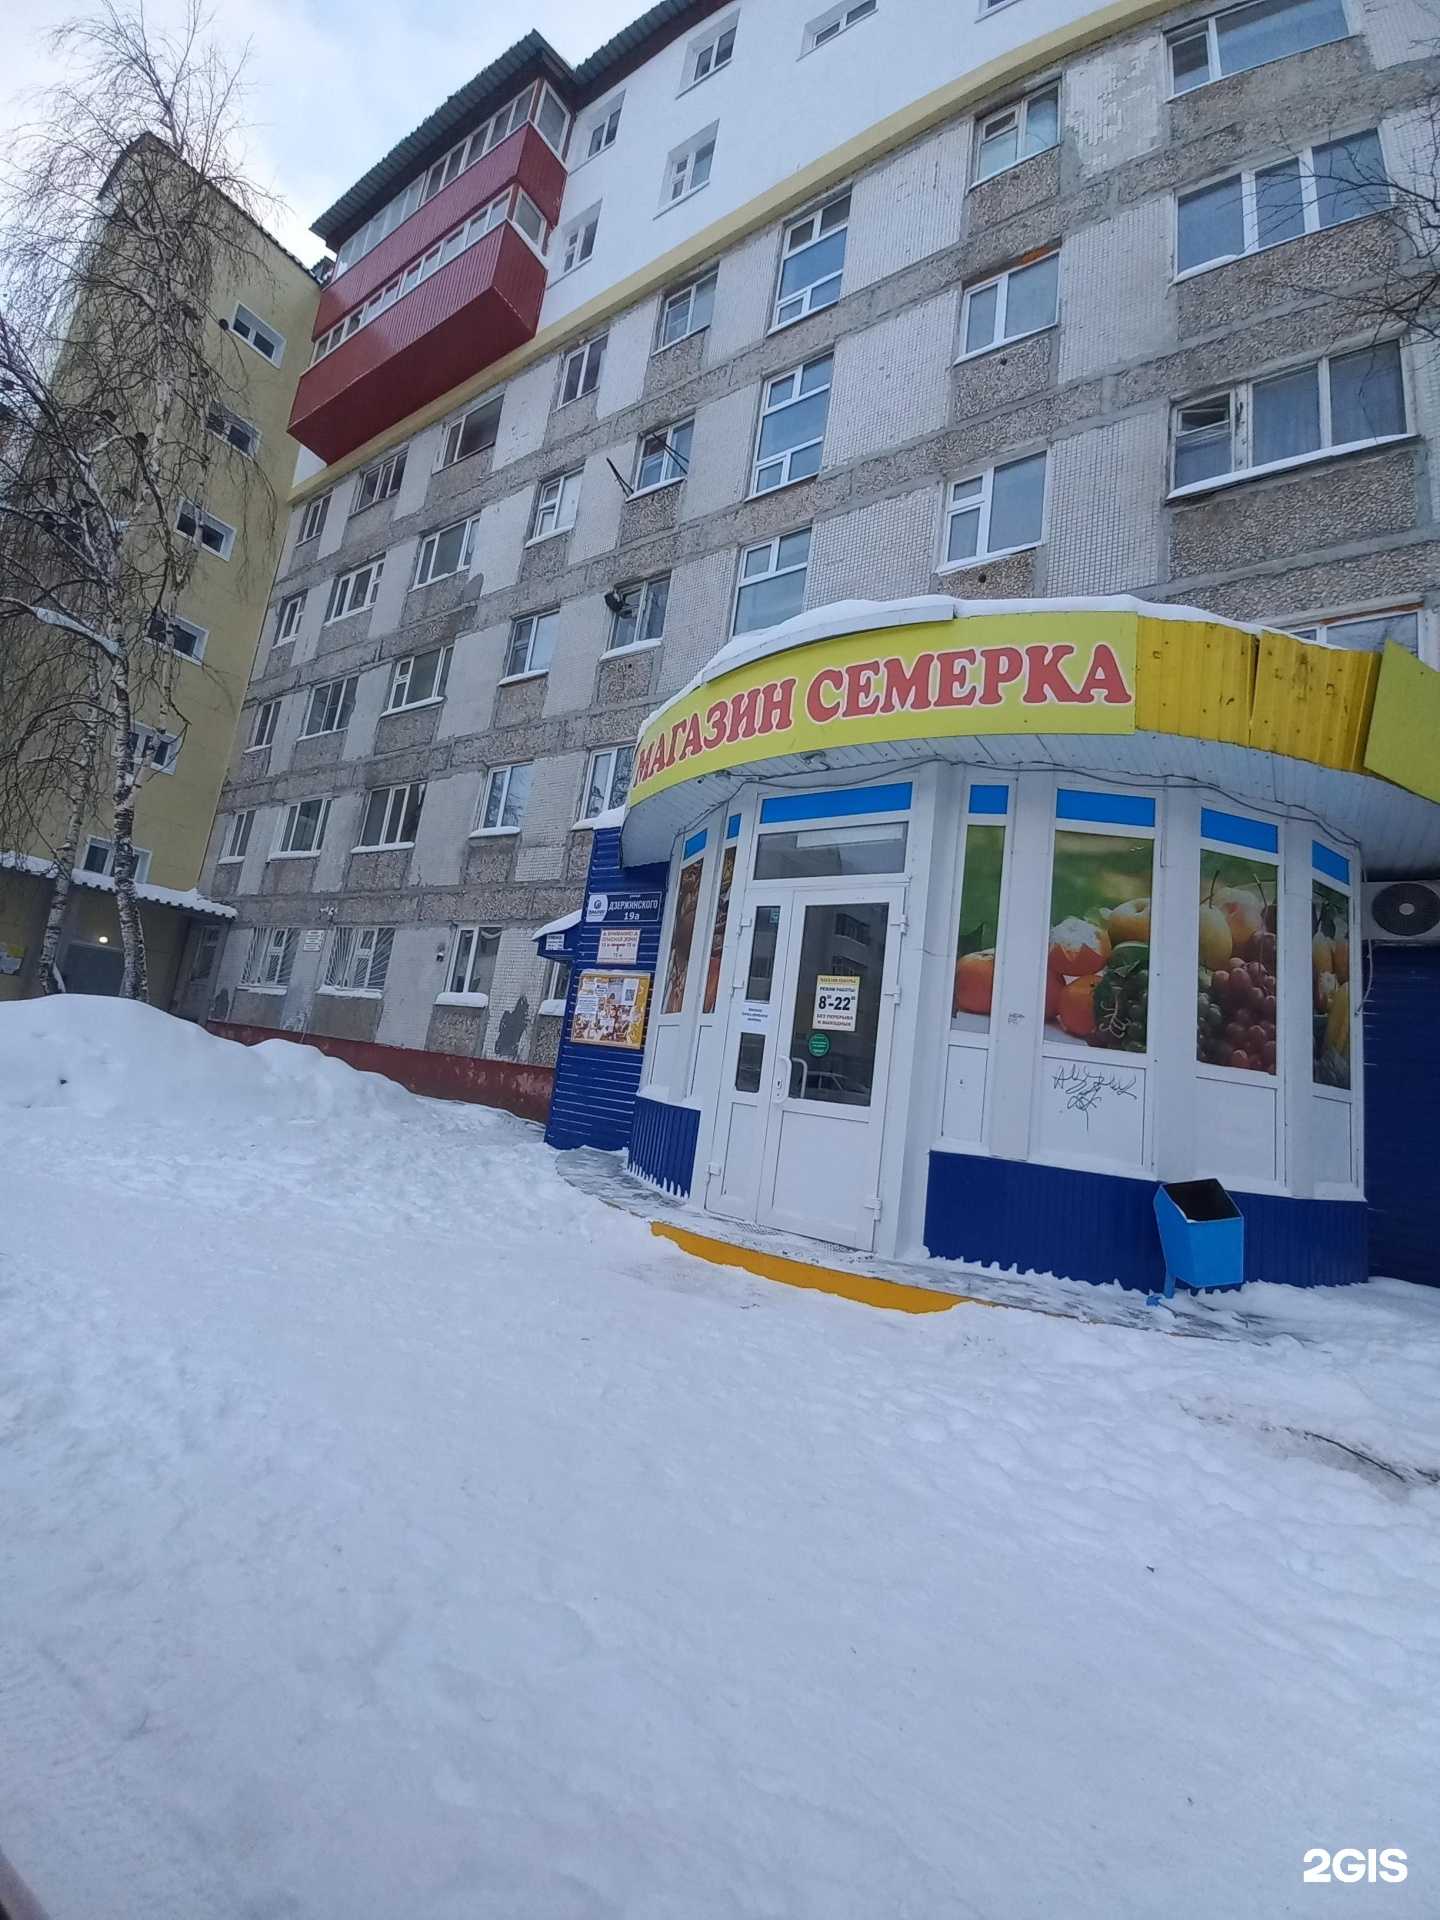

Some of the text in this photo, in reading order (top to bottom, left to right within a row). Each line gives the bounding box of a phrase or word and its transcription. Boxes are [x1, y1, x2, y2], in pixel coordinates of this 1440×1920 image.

[633, 643, 1133, 788] МАГАЗИН СЕМЕРКА
[608, 900, 659, 911] ДЗЕРЖИНСКОГО
